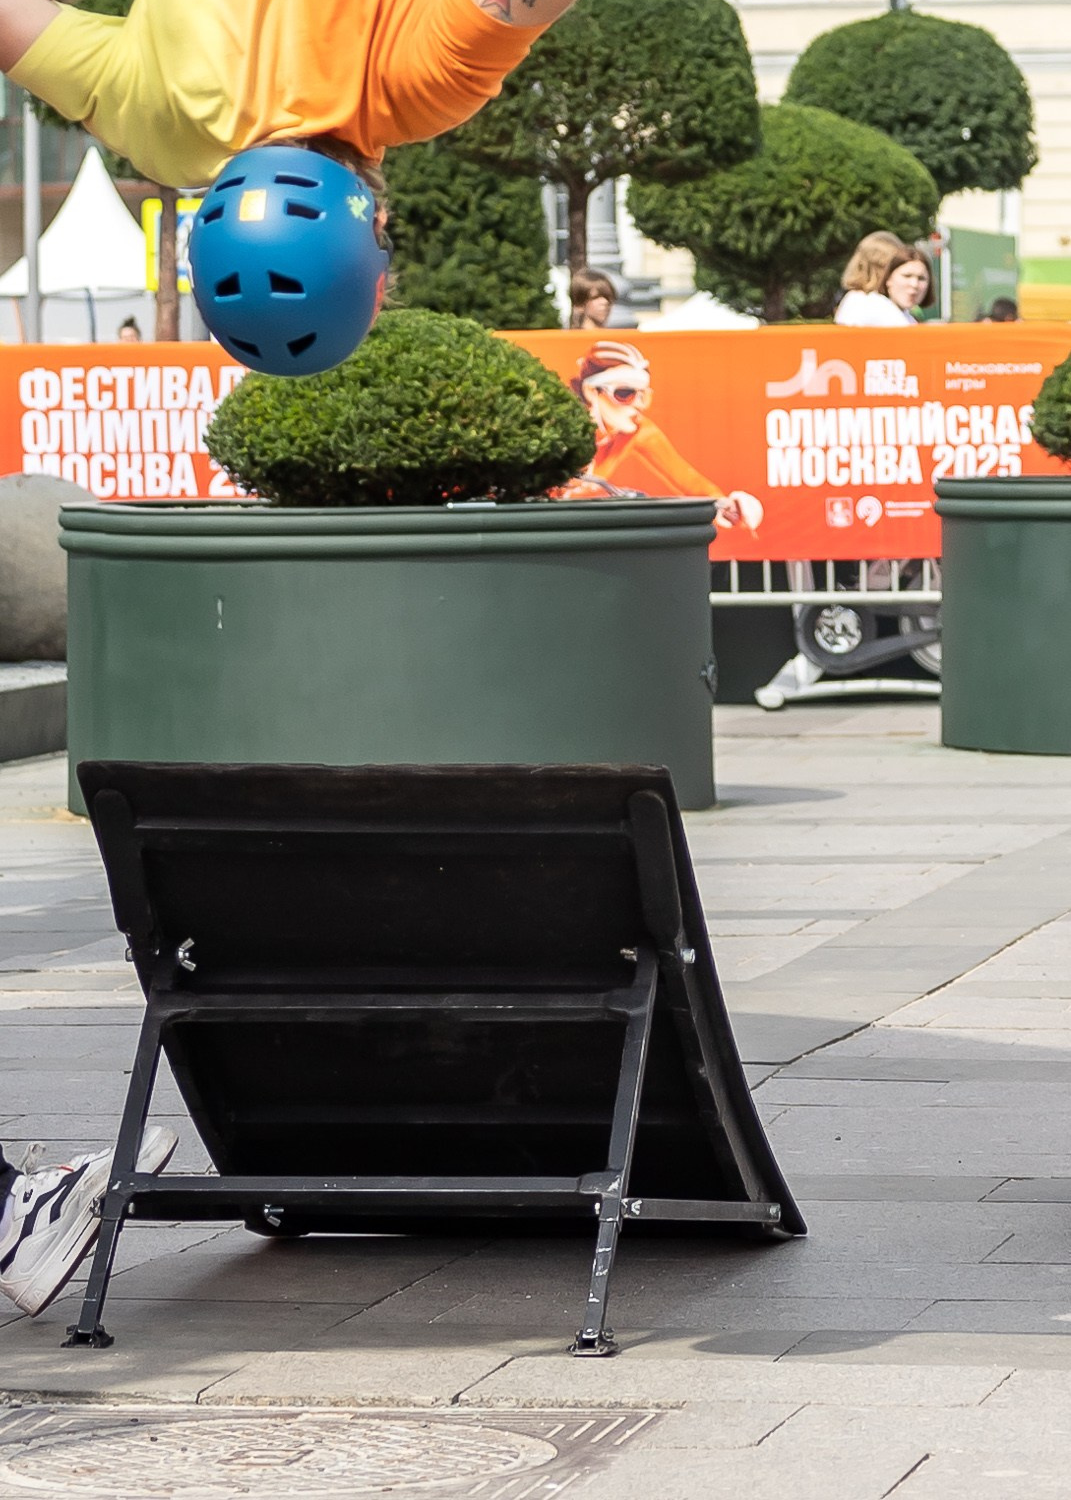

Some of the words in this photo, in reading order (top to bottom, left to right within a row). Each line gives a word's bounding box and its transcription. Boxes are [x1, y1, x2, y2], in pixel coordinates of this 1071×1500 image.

[18, 365, 249, 411] ФЕСТИВАЛ
[767, 445, 924, 487] МОСКВА
[932, 443, 1023, 484] 2025
